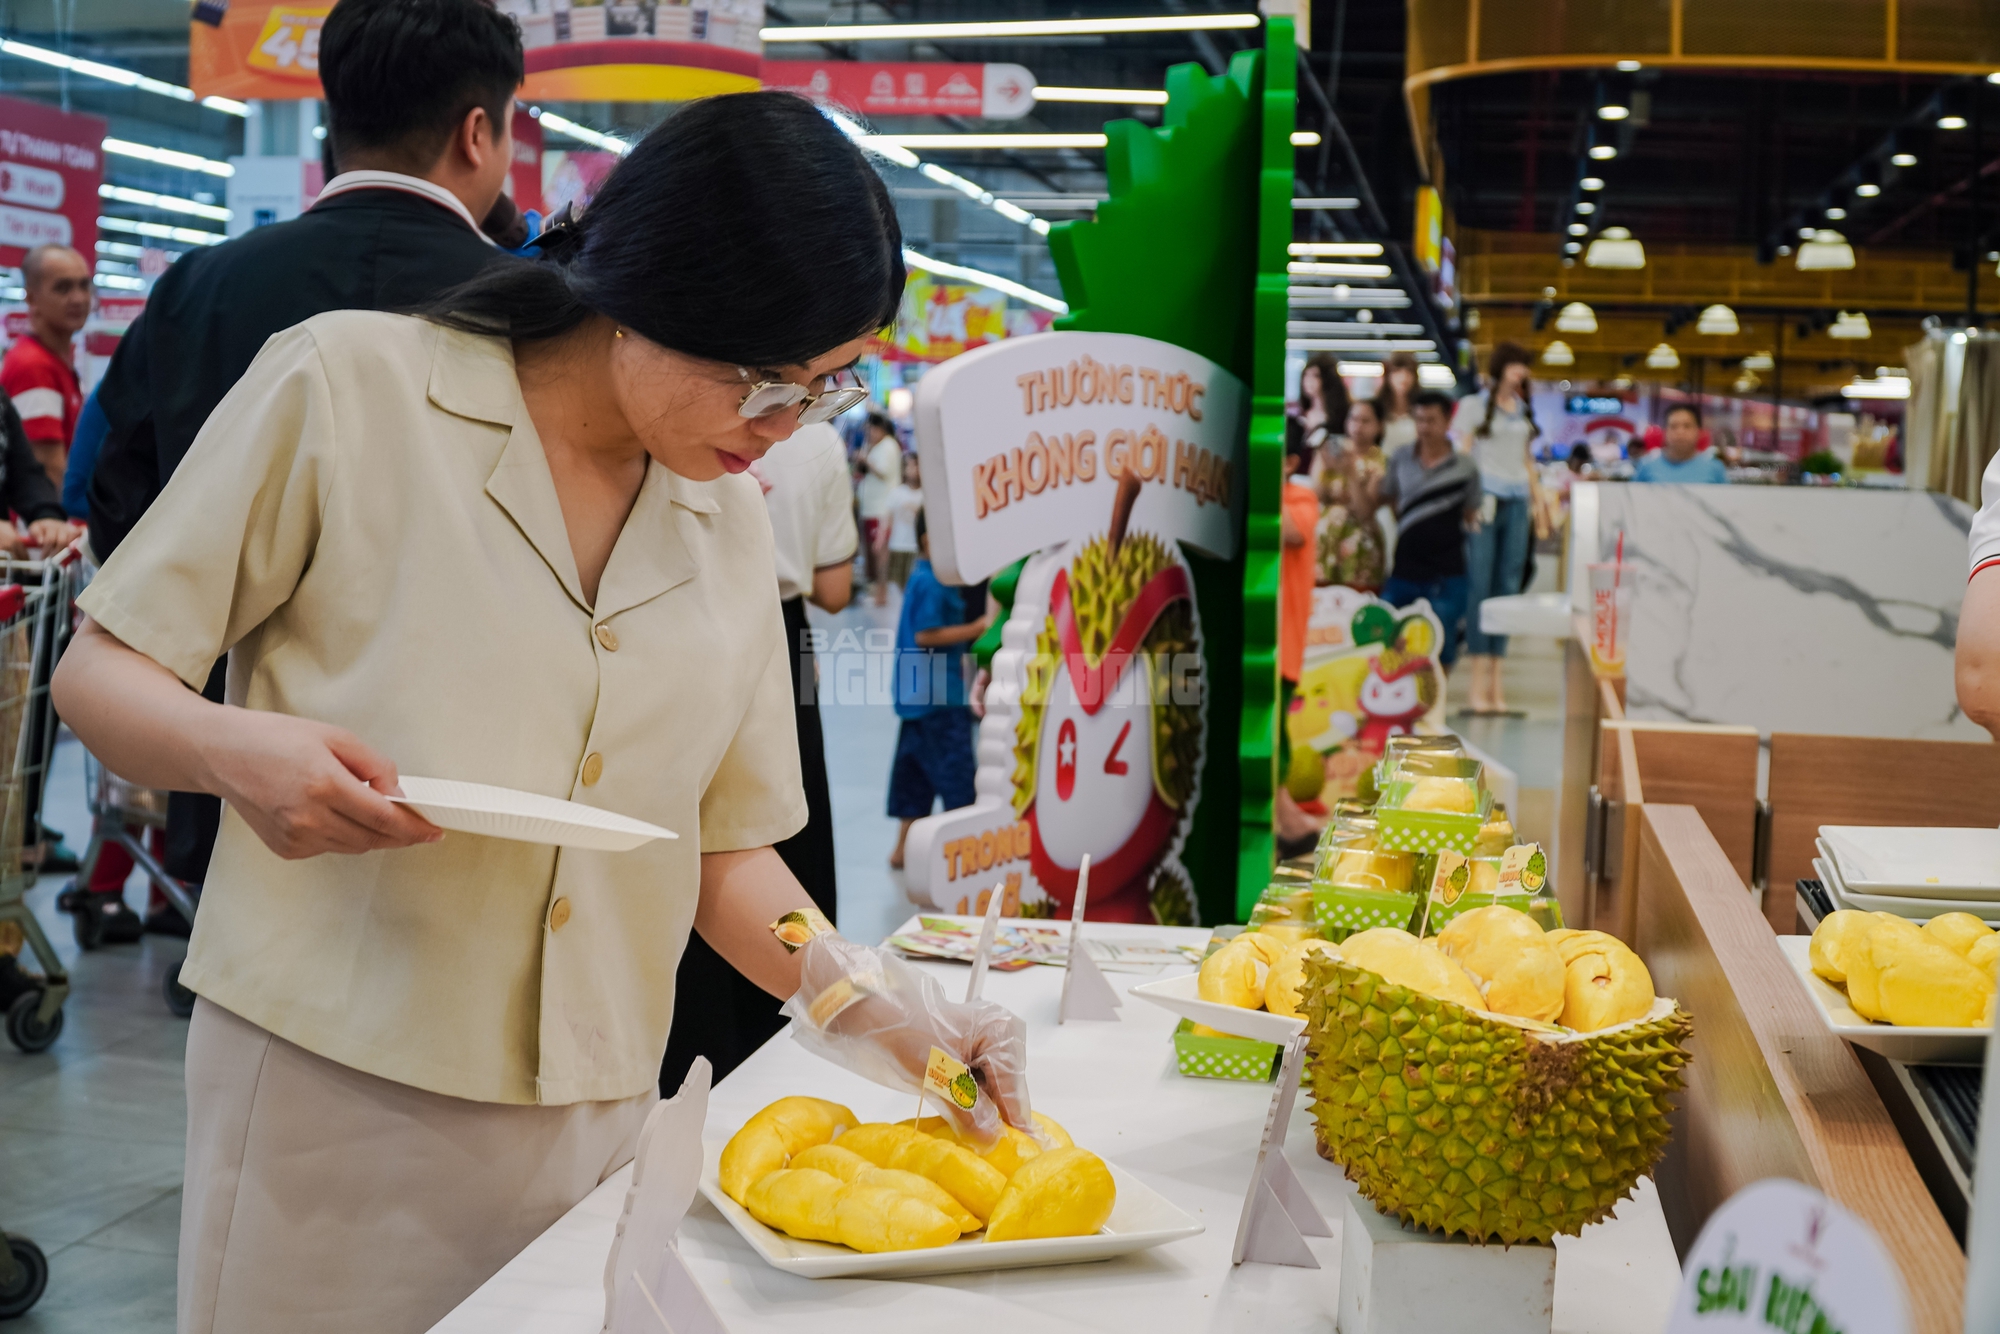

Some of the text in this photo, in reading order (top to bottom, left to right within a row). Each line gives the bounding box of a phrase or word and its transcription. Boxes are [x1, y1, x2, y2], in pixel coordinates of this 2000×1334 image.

[1016, 353, 1206, 422] THƯỞNG THỨC
[972, 422, 1234, 519] KHÔNG GIỚI HẠN
[944, 820, 1031, 882] TRONG
